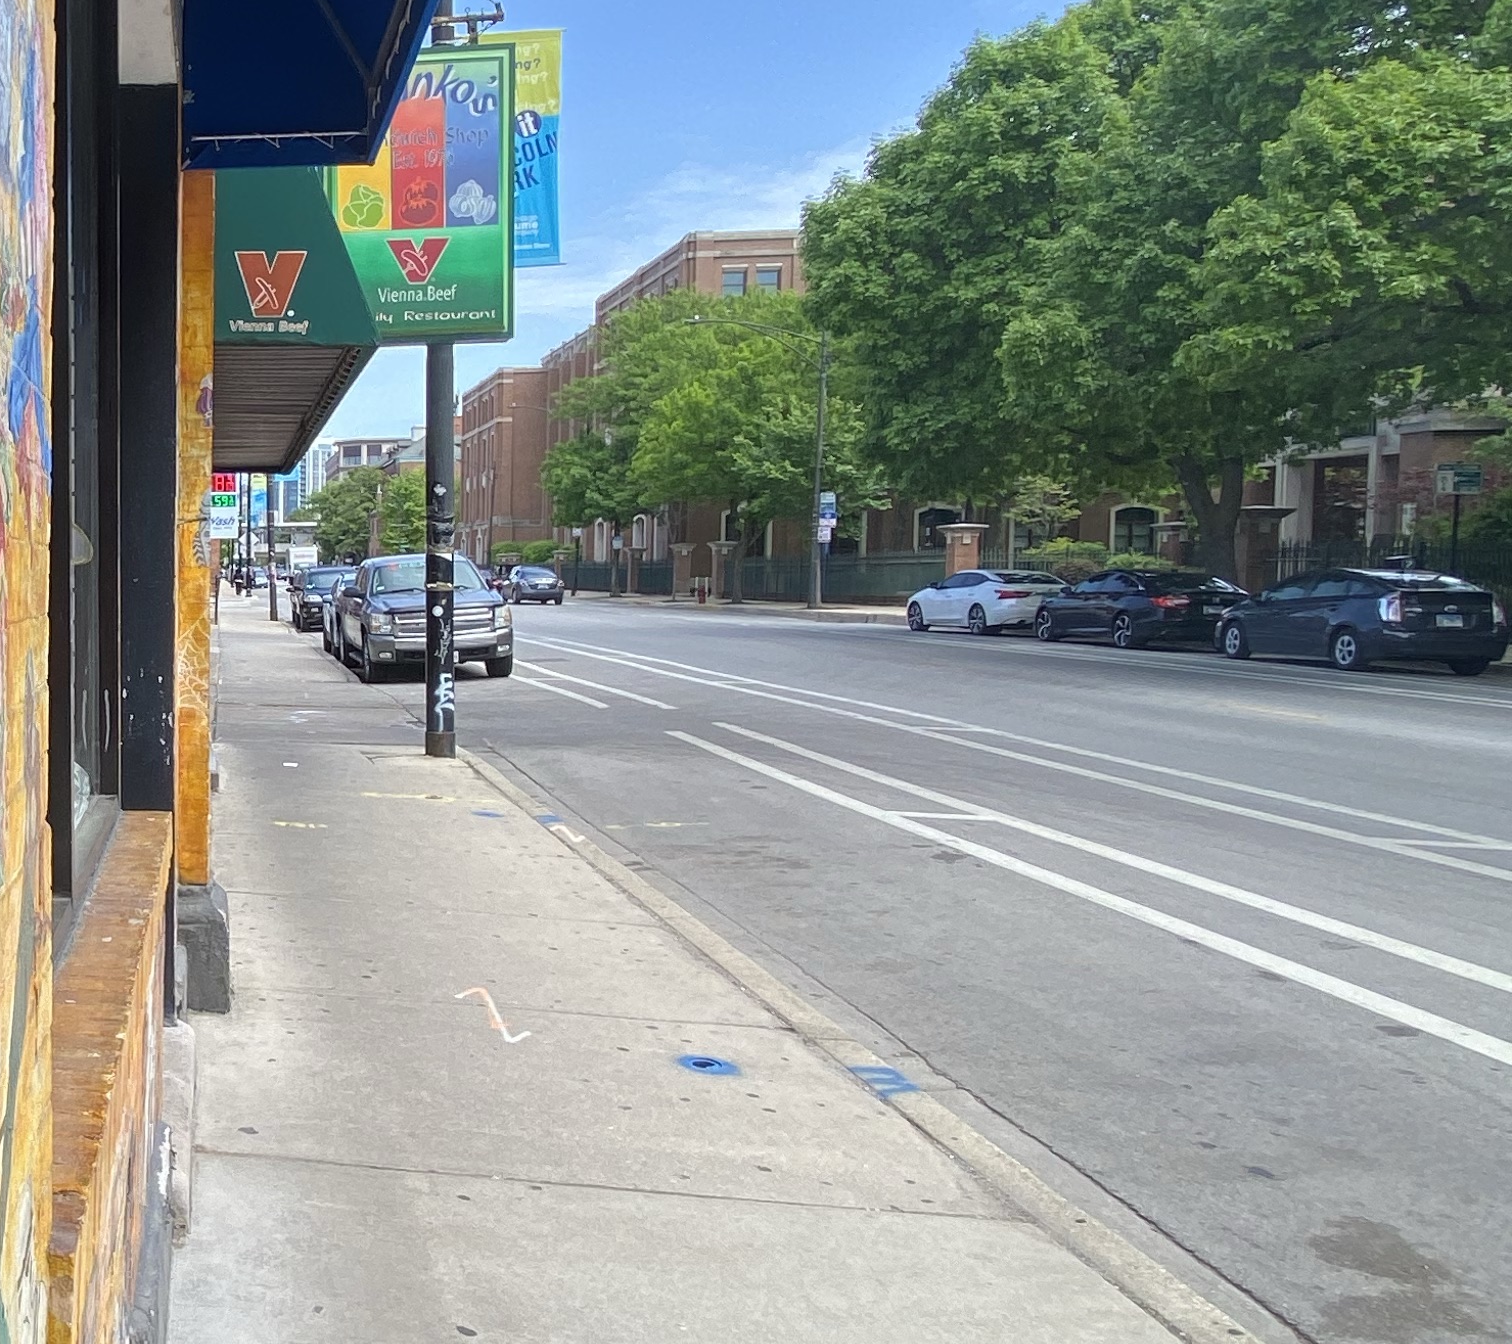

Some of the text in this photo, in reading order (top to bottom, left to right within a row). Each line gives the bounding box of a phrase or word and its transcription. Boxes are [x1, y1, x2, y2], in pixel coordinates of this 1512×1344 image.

[445, 127, 489, 149] Shop
[377, 284, 458, 303] Vienna Beef
[404, 309, 496, 321] Restaurant
[229, 320, 309, 335] Vienna Beef
